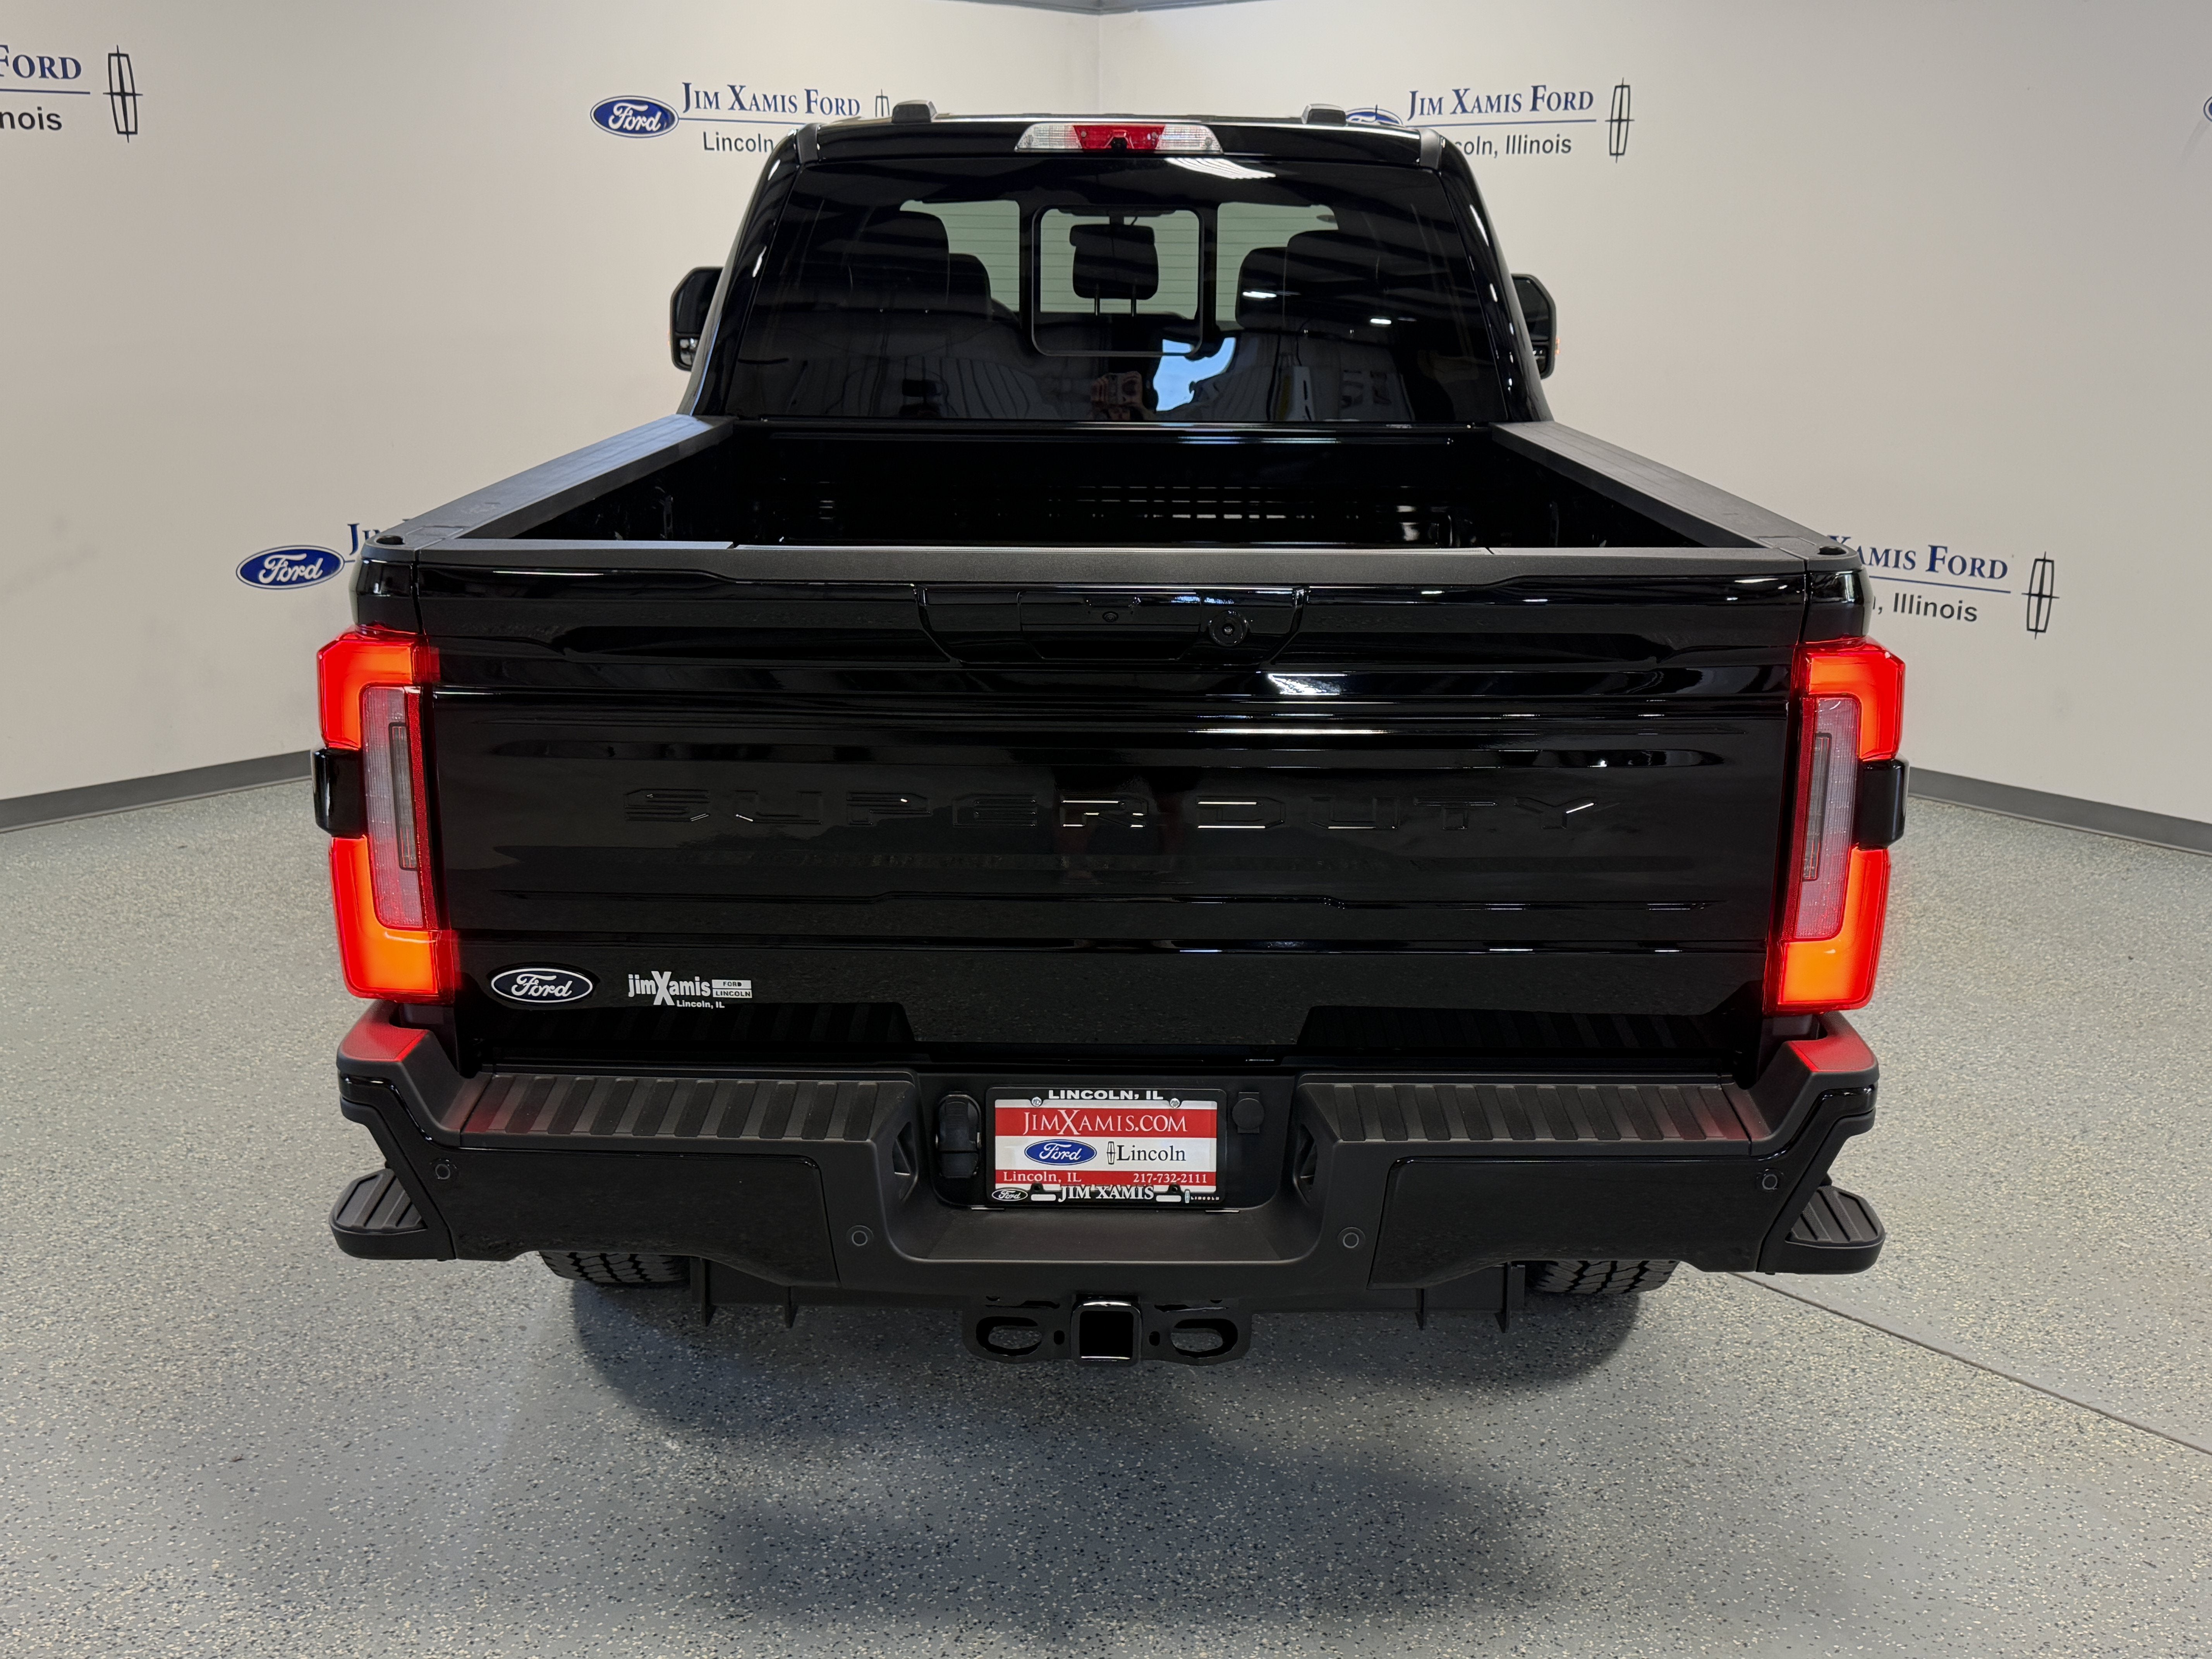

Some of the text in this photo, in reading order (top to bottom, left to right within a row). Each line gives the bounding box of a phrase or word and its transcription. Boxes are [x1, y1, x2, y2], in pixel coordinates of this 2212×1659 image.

[608, 102, 661, 132] Ford
[1506, 134, 1572, 155] Illinois
[259, 553, 324, 584] Ford
[1893, 592, 1978, 622] Illinois
[624, 788, 1598, 830] SUPER DUTY
[510, 973, 573, 998] Ford
[676, 1000, 714, 1009] Lincoln,
[1048, 1090, 1164, 1101] LINCOLN, IL
[1039, 1144, 1082, 1162] Ford
[1116, 1145, 1187, 1162] Lincoln
[1003, 1171, 1082, 1183] Lincoln, IL
[1133, 1173, 1207, 1184] 217-732-2111
[998, 1189, 1021, 1199] Ford
[1058, 1185, 1154, 1202] JIM XAMIS
